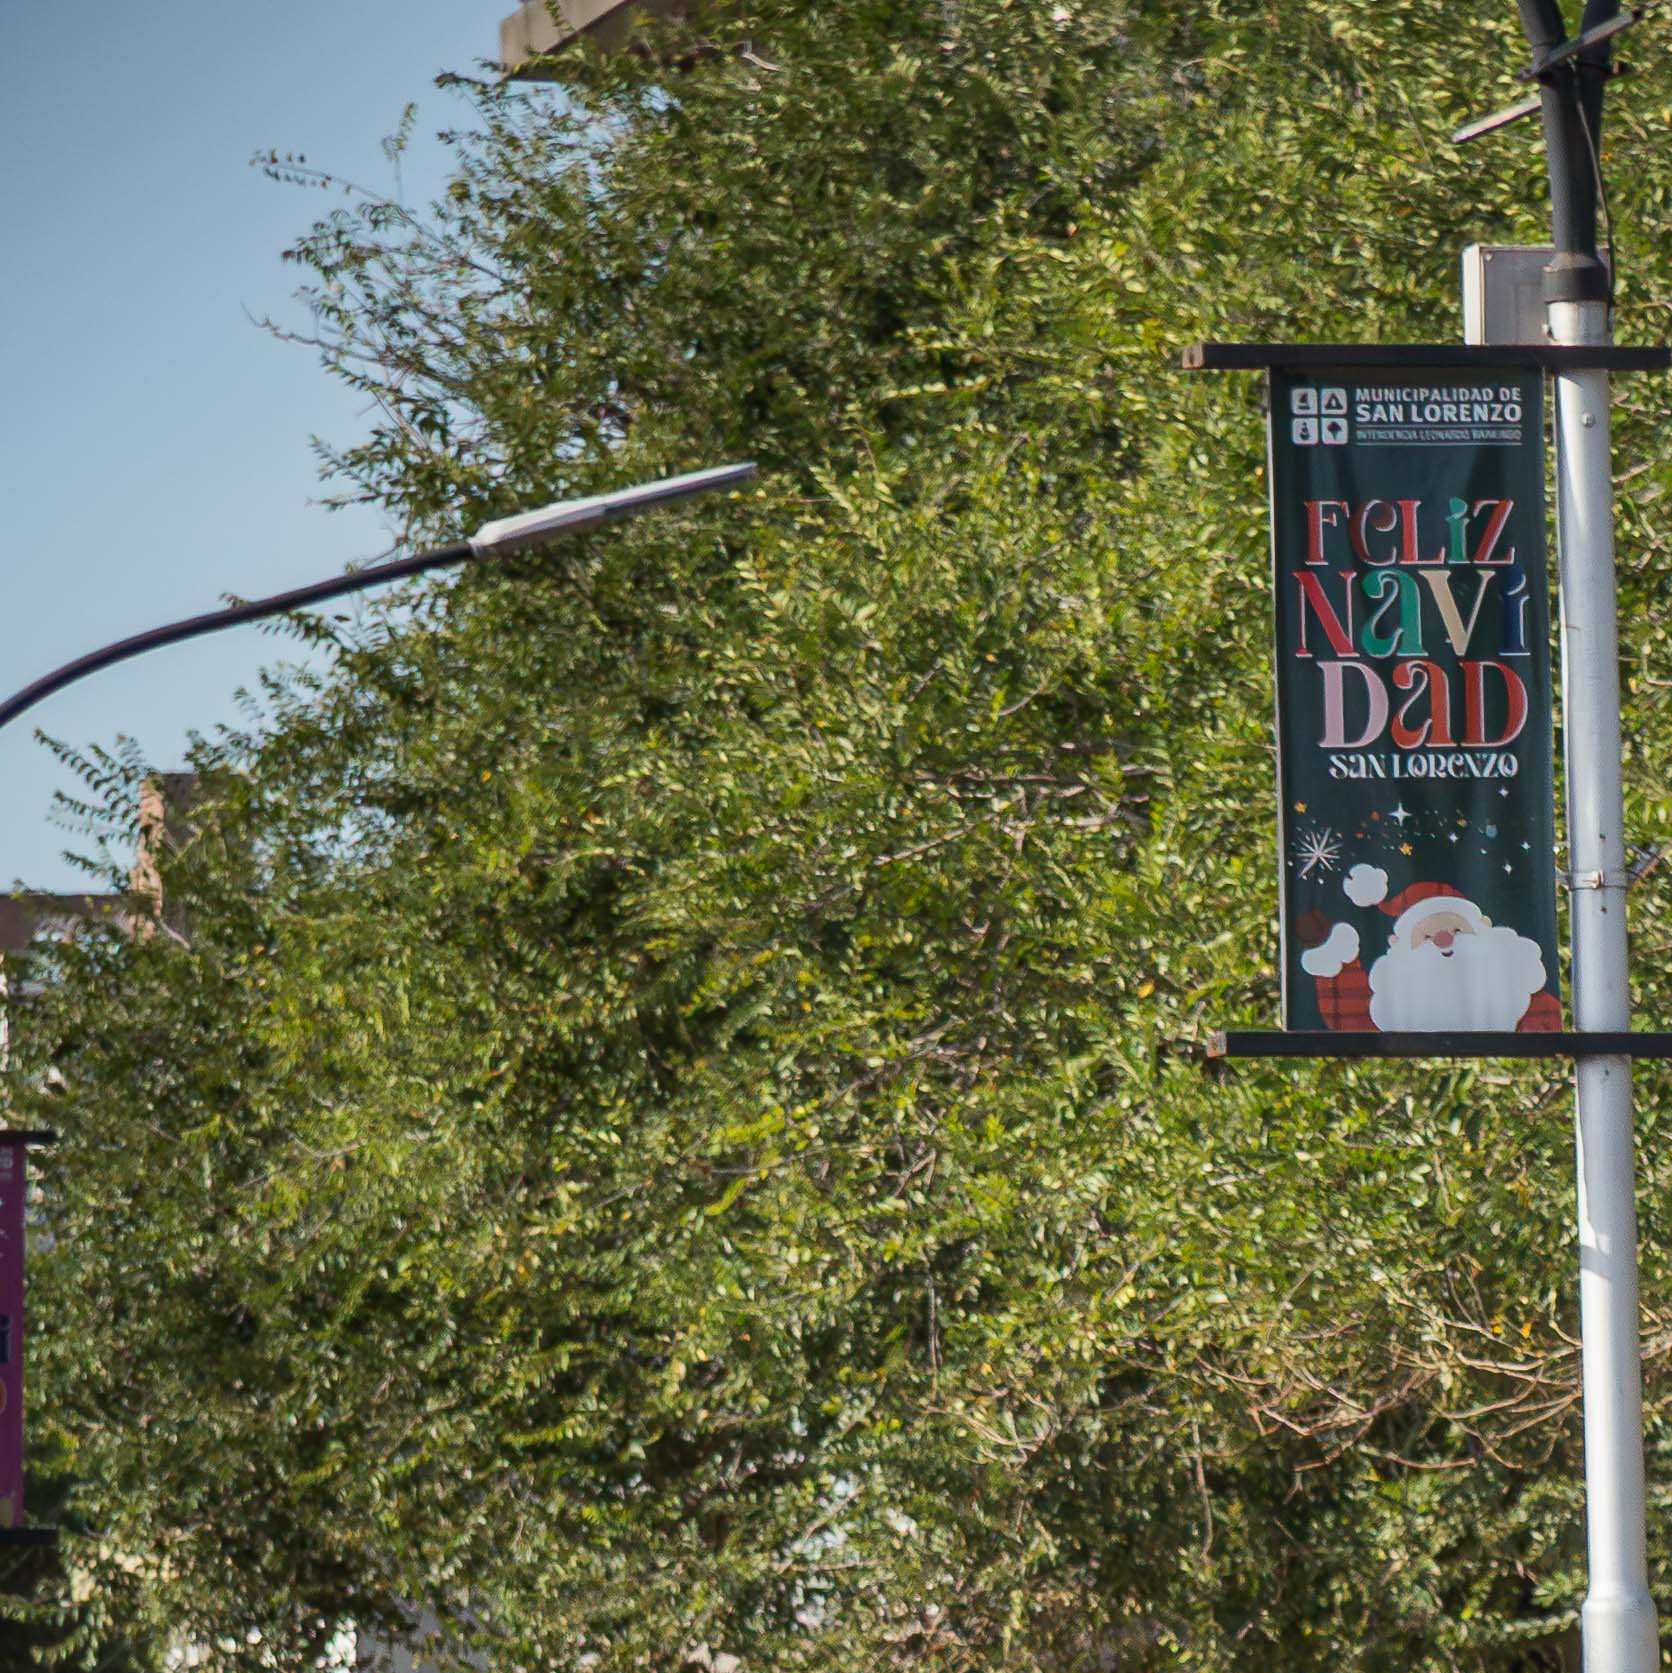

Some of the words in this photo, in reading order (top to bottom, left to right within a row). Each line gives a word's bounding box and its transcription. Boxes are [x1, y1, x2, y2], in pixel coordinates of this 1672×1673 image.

[1355, 387, 1493, 402] MUNICIPALIDAD
[1499, 387, 1521, 401] DE
[1355, 403, 1404, 422] SAN
[1410, 403, 1522, 422] LORENZO
